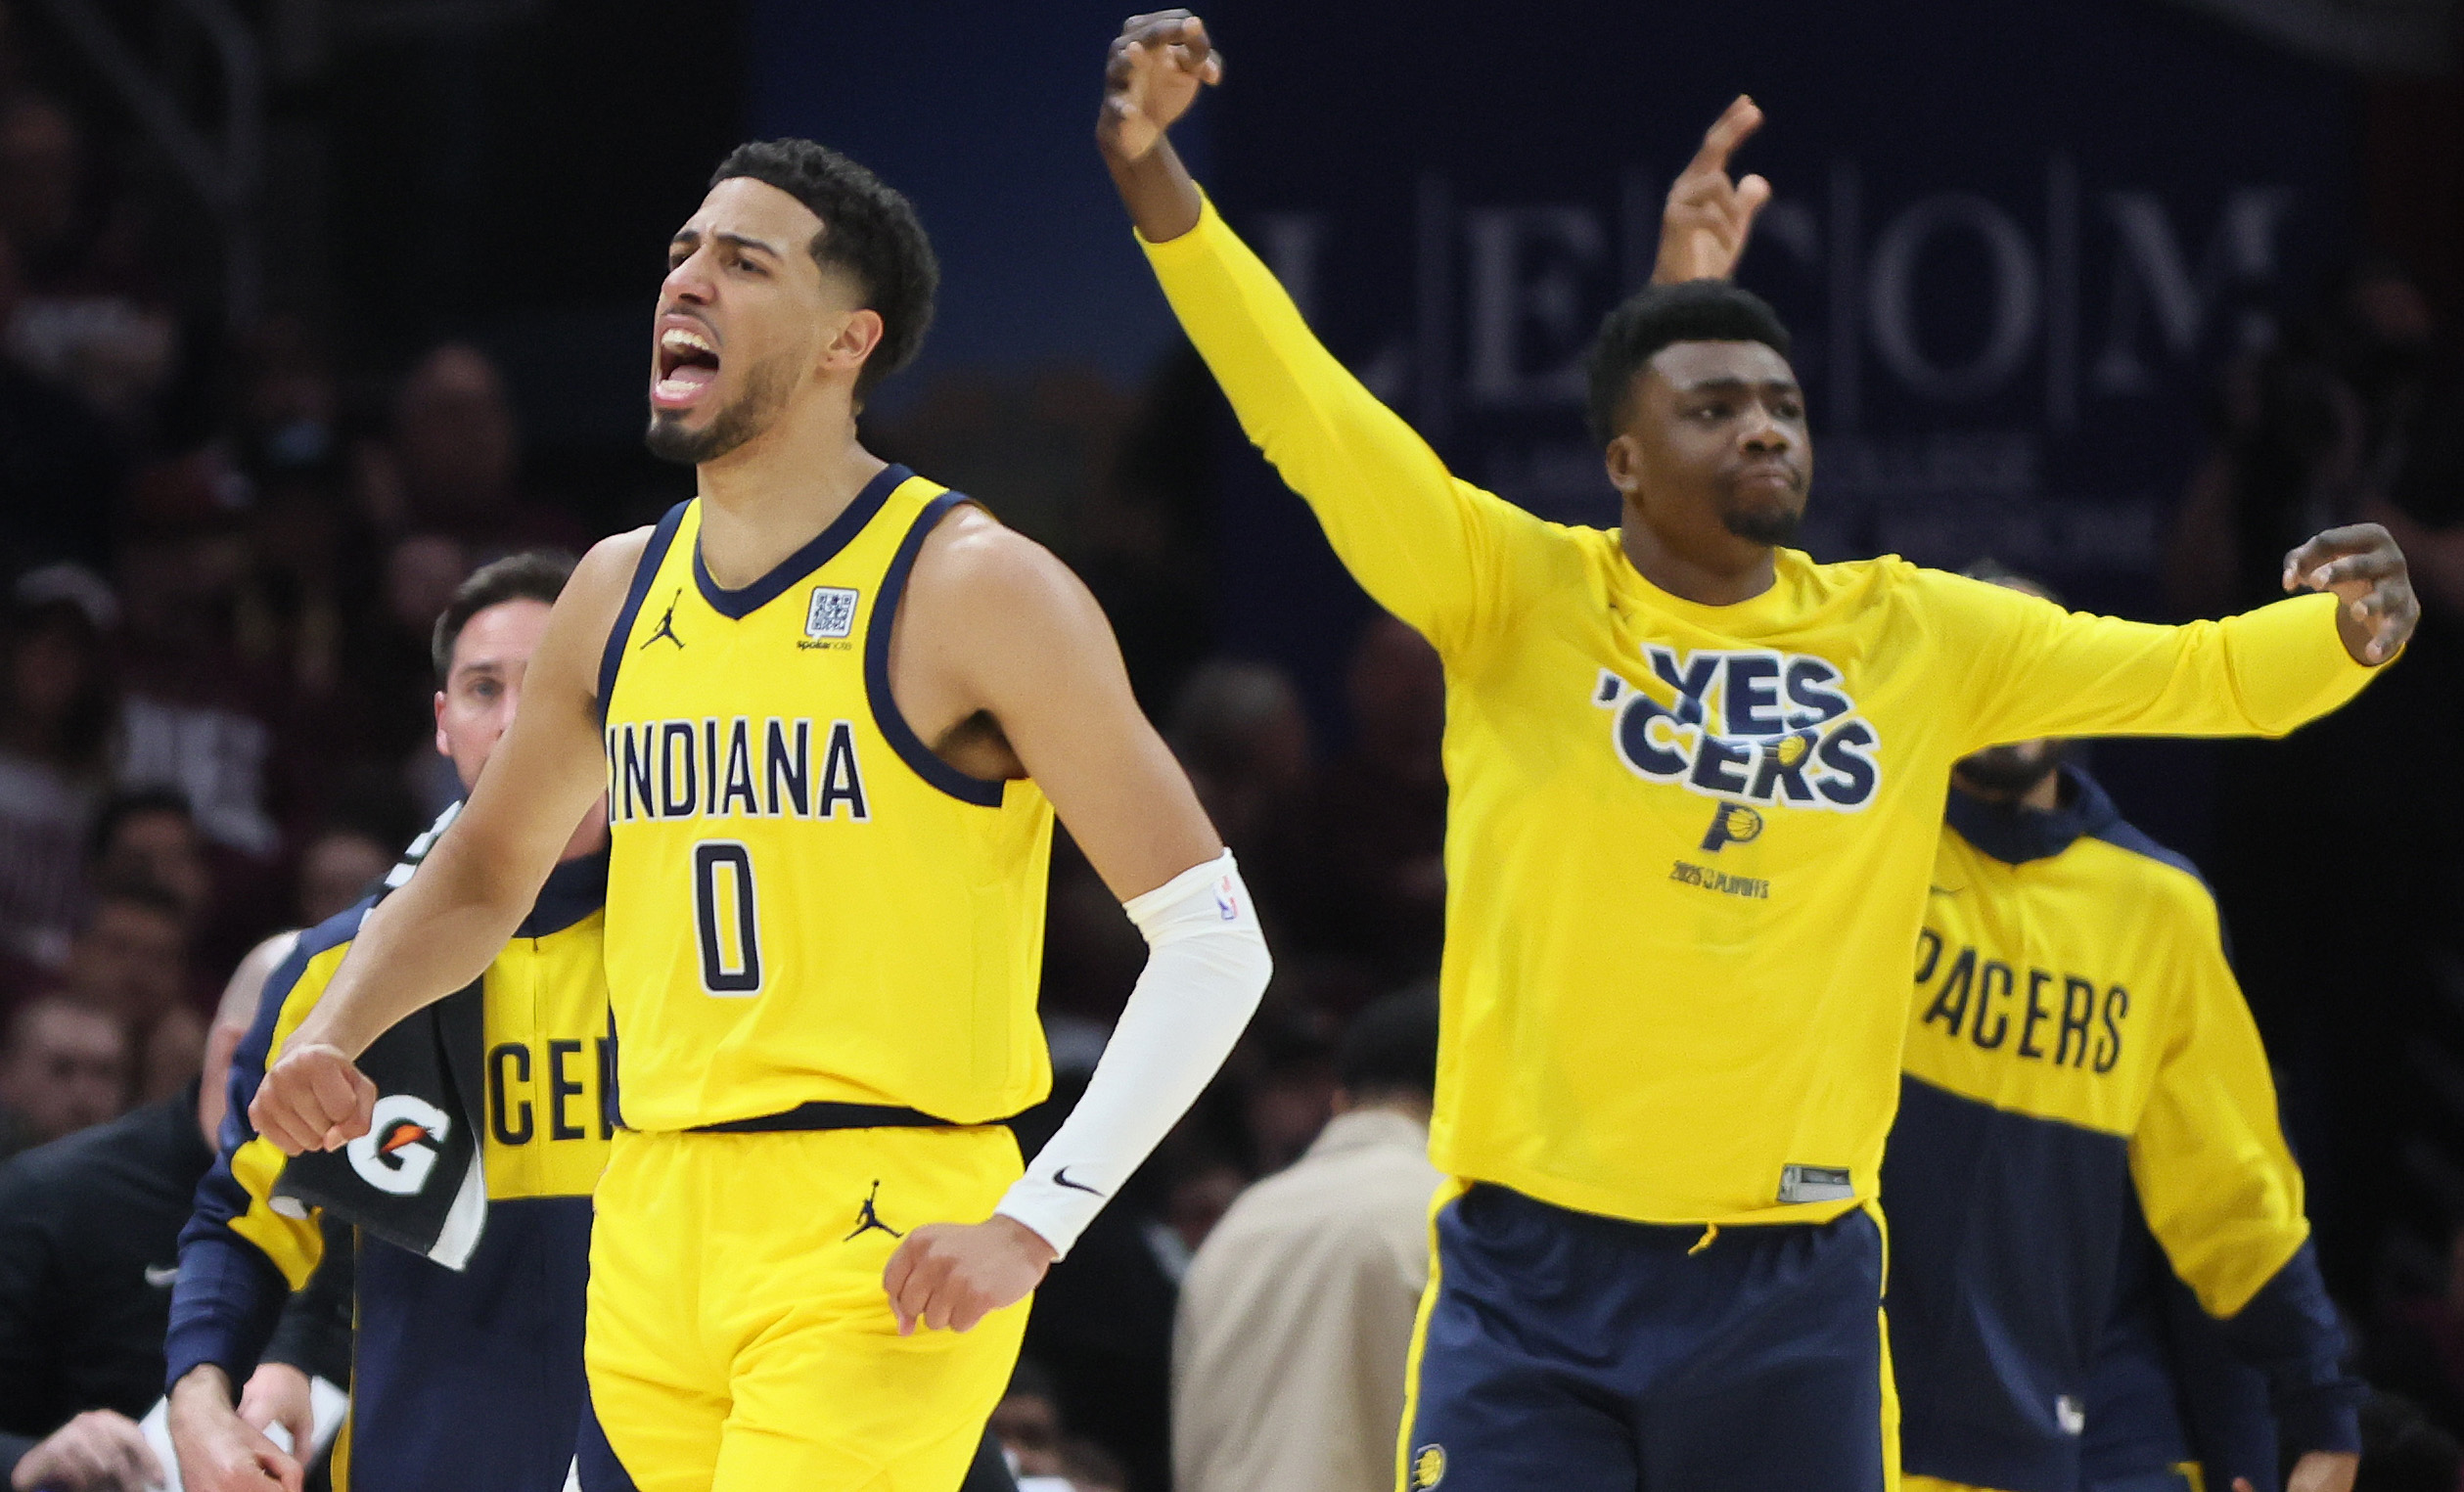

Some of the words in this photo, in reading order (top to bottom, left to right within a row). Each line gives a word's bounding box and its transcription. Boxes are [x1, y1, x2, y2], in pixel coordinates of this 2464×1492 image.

[1642, 642, 1855, 735] YES
[607, 717, 870, 825] INDIANA
[694, 839, 762, 997] 0
